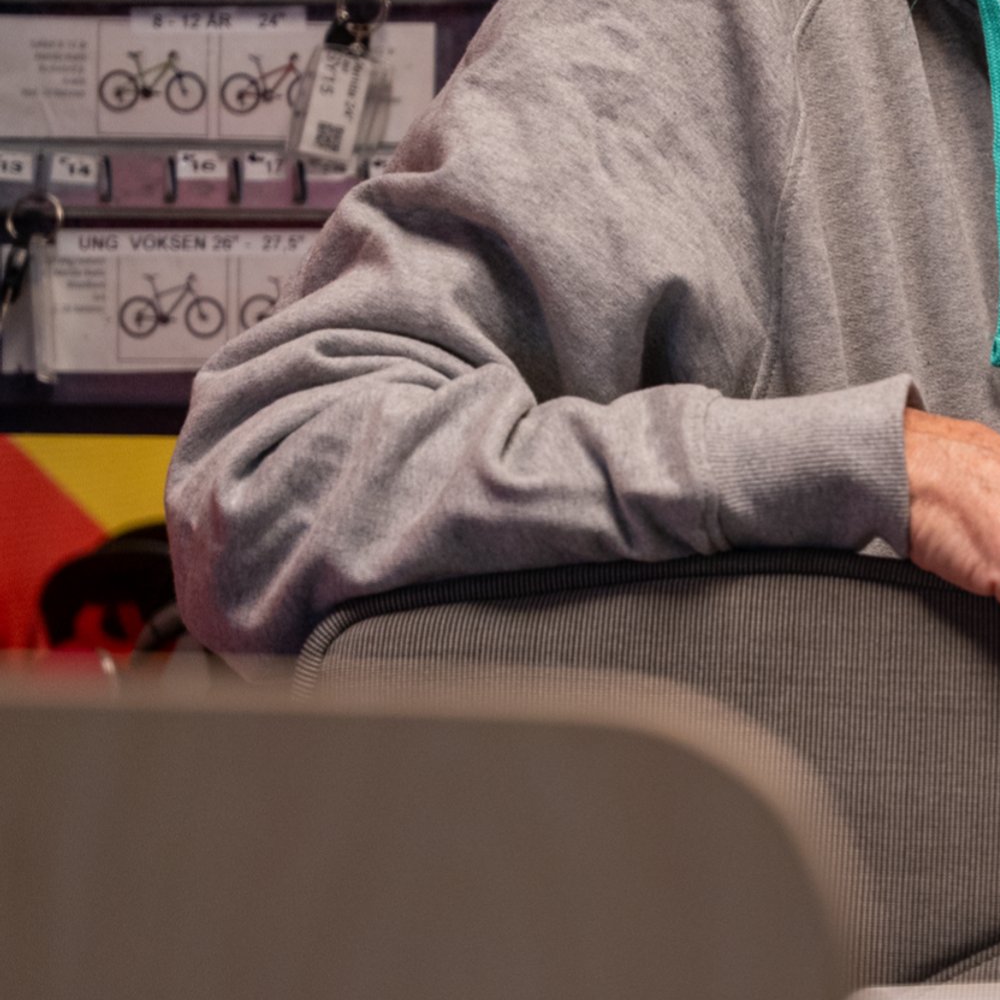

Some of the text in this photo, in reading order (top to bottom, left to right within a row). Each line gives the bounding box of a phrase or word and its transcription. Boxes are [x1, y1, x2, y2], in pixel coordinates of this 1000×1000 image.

[182, 12, 200, 29] 12
[68, 163, 90, 176] 14
[266, 159, 284, 173] 17
[78, 234, 119, 250] UNG
[129, 234, 207, 251] VOKSEN
